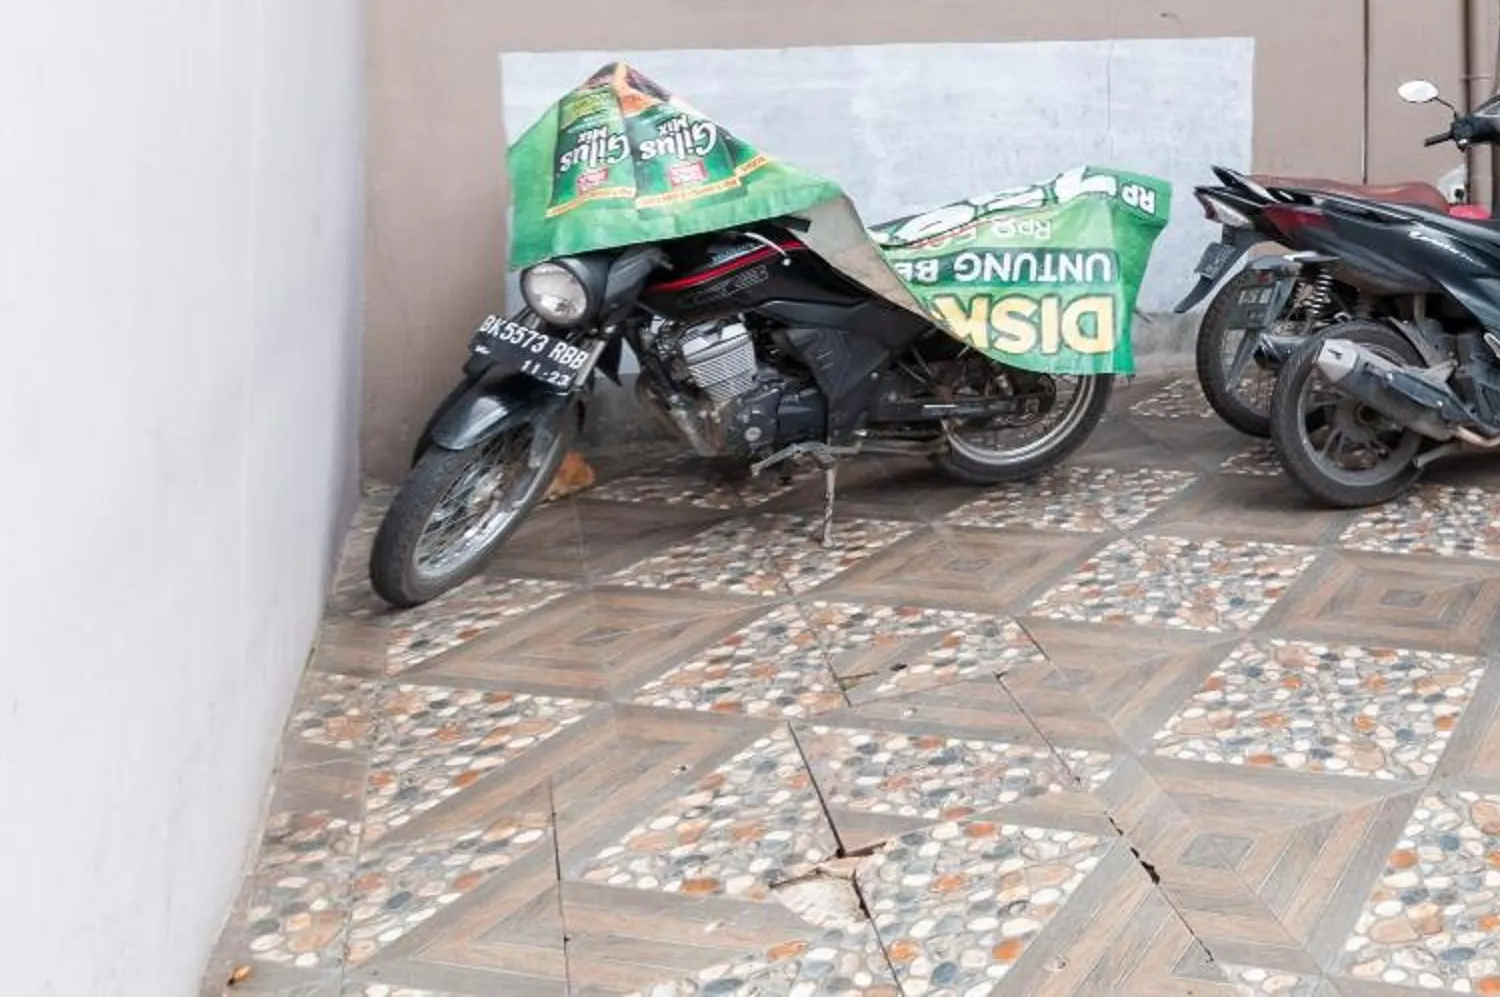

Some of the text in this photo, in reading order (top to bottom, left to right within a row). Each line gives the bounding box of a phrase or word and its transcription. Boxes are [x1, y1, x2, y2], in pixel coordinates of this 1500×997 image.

[578, 125, 608, 143] Mix
[659, 113, 688, 135] Mix
[560, 133, 629, 172] Gilus
[640, 121, 717, 161] Gilus
[953, 253, 1111, 283] UNTUNG
